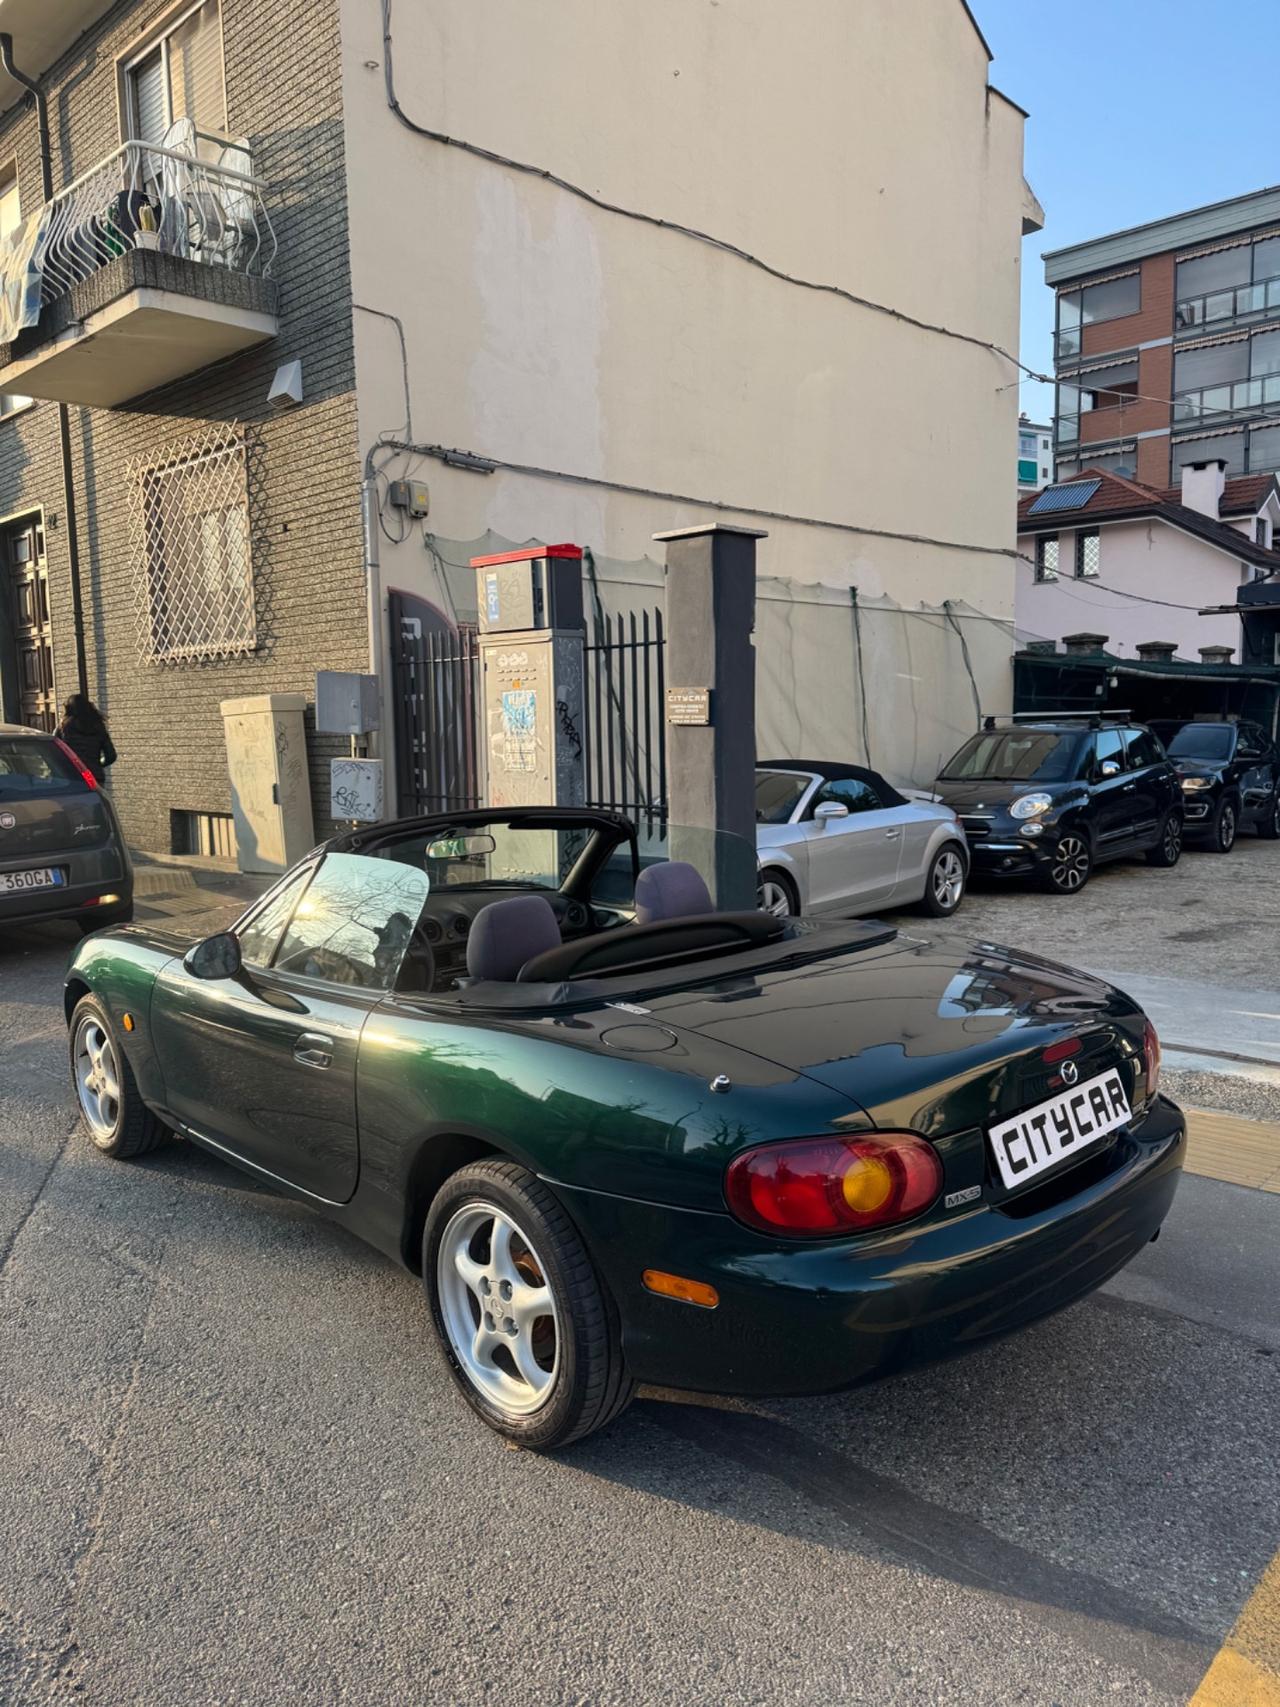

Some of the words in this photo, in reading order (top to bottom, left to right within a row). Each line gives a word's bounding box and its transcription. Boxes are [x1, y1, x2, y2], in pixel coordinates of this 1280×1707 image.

[4, 868, 52, 889] 360GA
[1001, 1076, 1128, 1175] CITYCAR
[947, 1187, 980, 1205] MX-5
